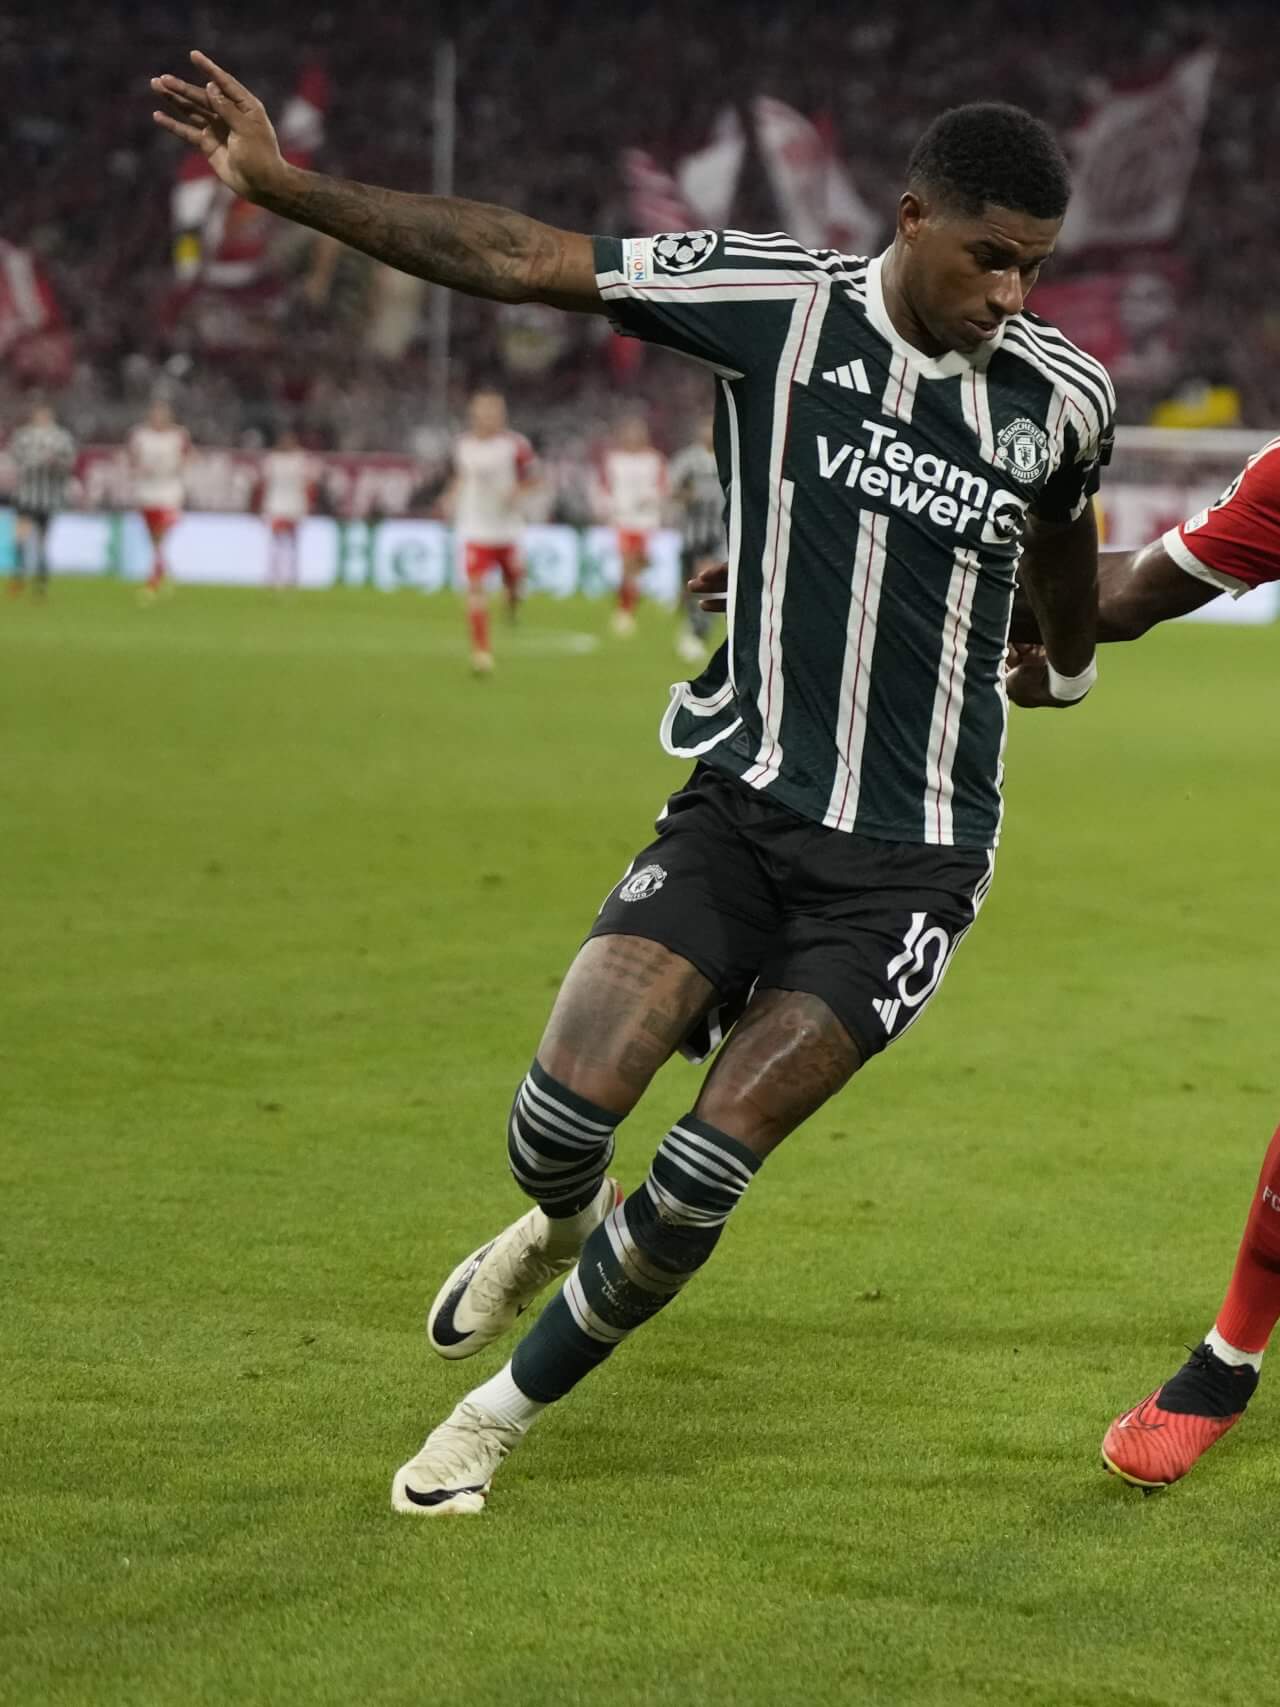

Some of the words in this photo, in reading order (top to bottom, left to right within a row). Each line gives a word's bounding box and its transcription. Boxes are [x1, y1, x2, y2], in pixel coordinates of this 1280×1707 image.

[816, 435, 982, 534] Viewer
[861, 419, 989, 509] Team
[1011, 467, 1040, 480] UNITED
[887, 912, 949, 1007] 10
